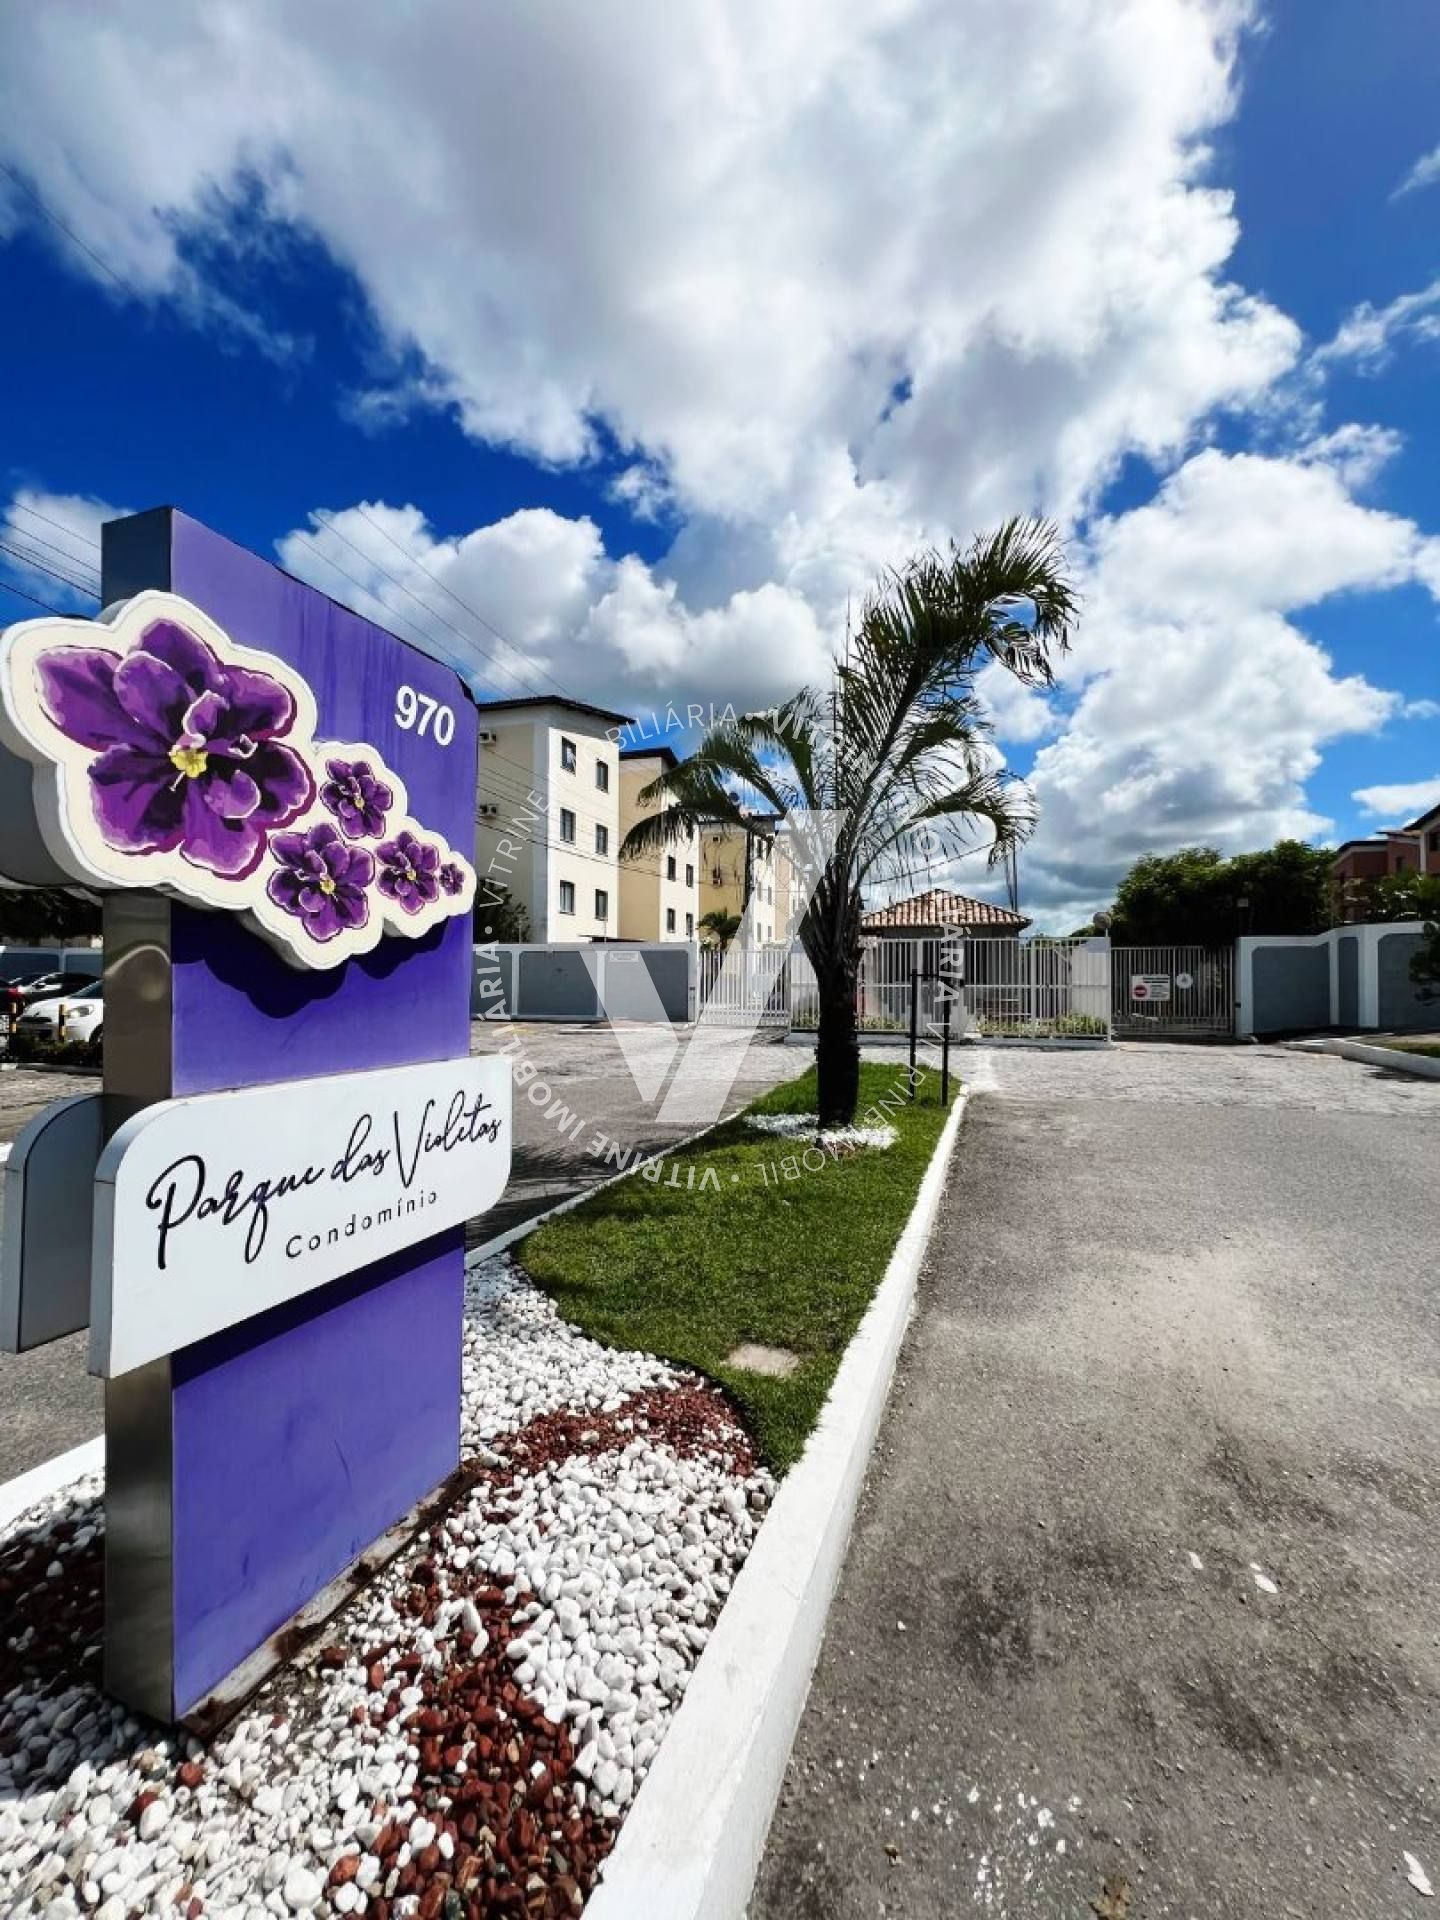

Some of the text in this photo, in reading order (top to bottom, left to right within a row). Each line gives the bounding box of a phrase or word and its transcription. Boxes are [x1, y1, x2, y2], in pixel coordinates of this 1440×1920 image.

[394, 685, 456, 746] 970
[146, 1154, 324, 1270] Parque
[331, 1114, 390, 1183] das
[286, 1190, 438, 1259] Condomínio
